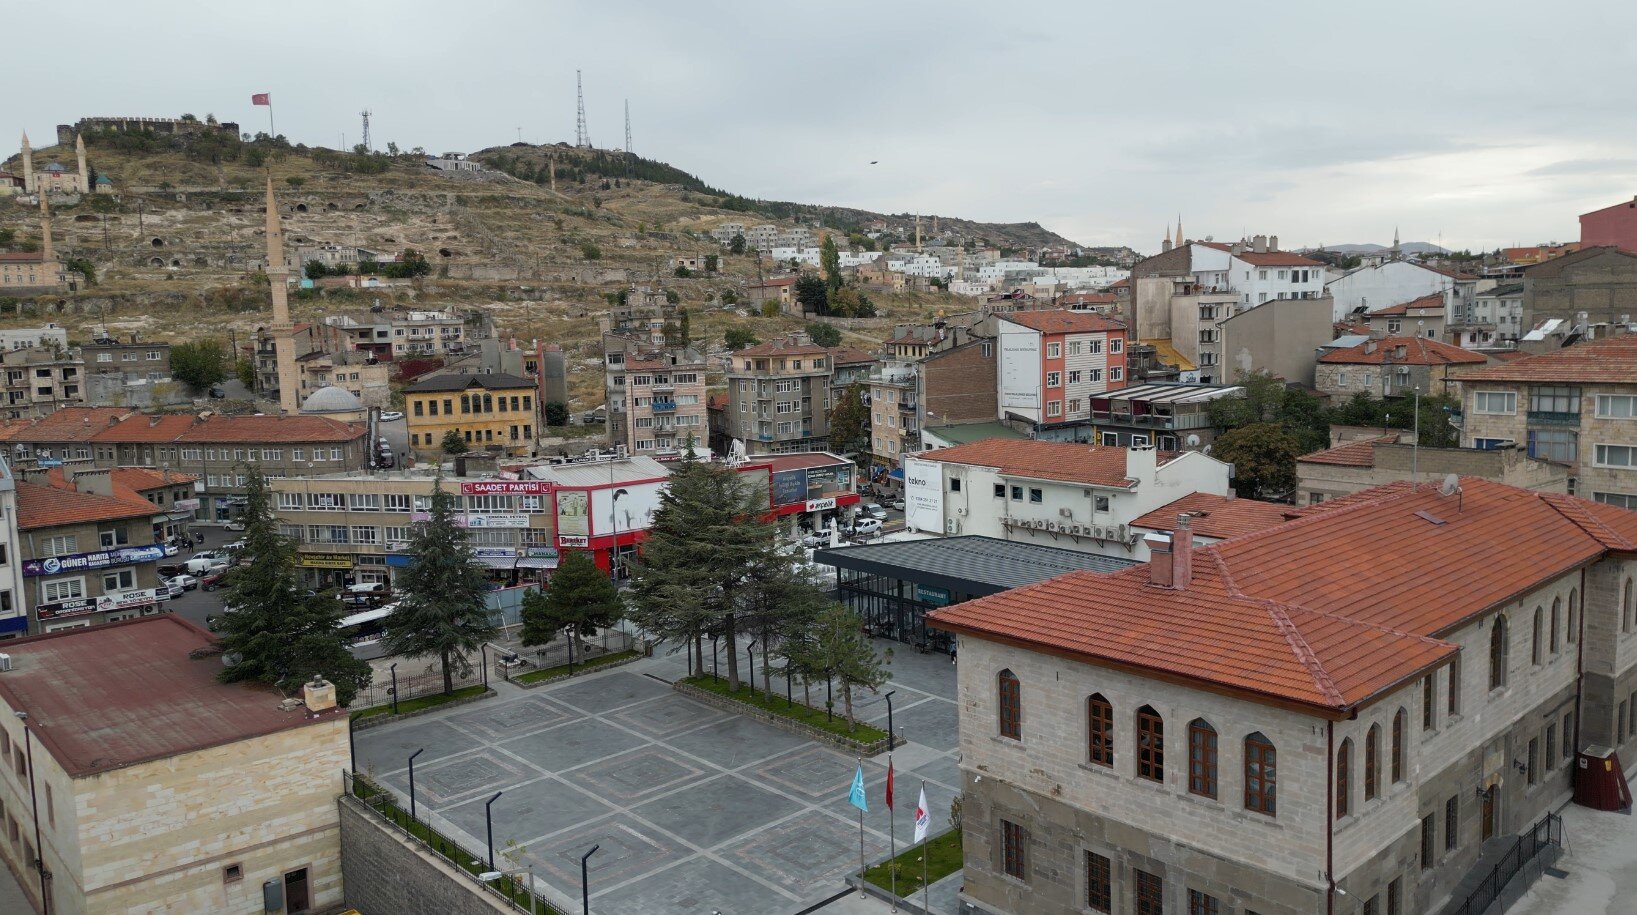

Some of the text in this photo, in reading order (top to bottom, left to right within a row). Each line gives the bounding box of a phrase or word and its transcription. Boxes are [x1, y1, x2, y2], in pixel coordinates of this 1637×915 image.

[908, 476, 926, 486] tekno
[509, 482, 539, 491] PARTİSİ
[61, 557, 88, 569] GÜNER
[123, 591, 147, 600] ROSE
[62, 600, 88, 609] ROSE
